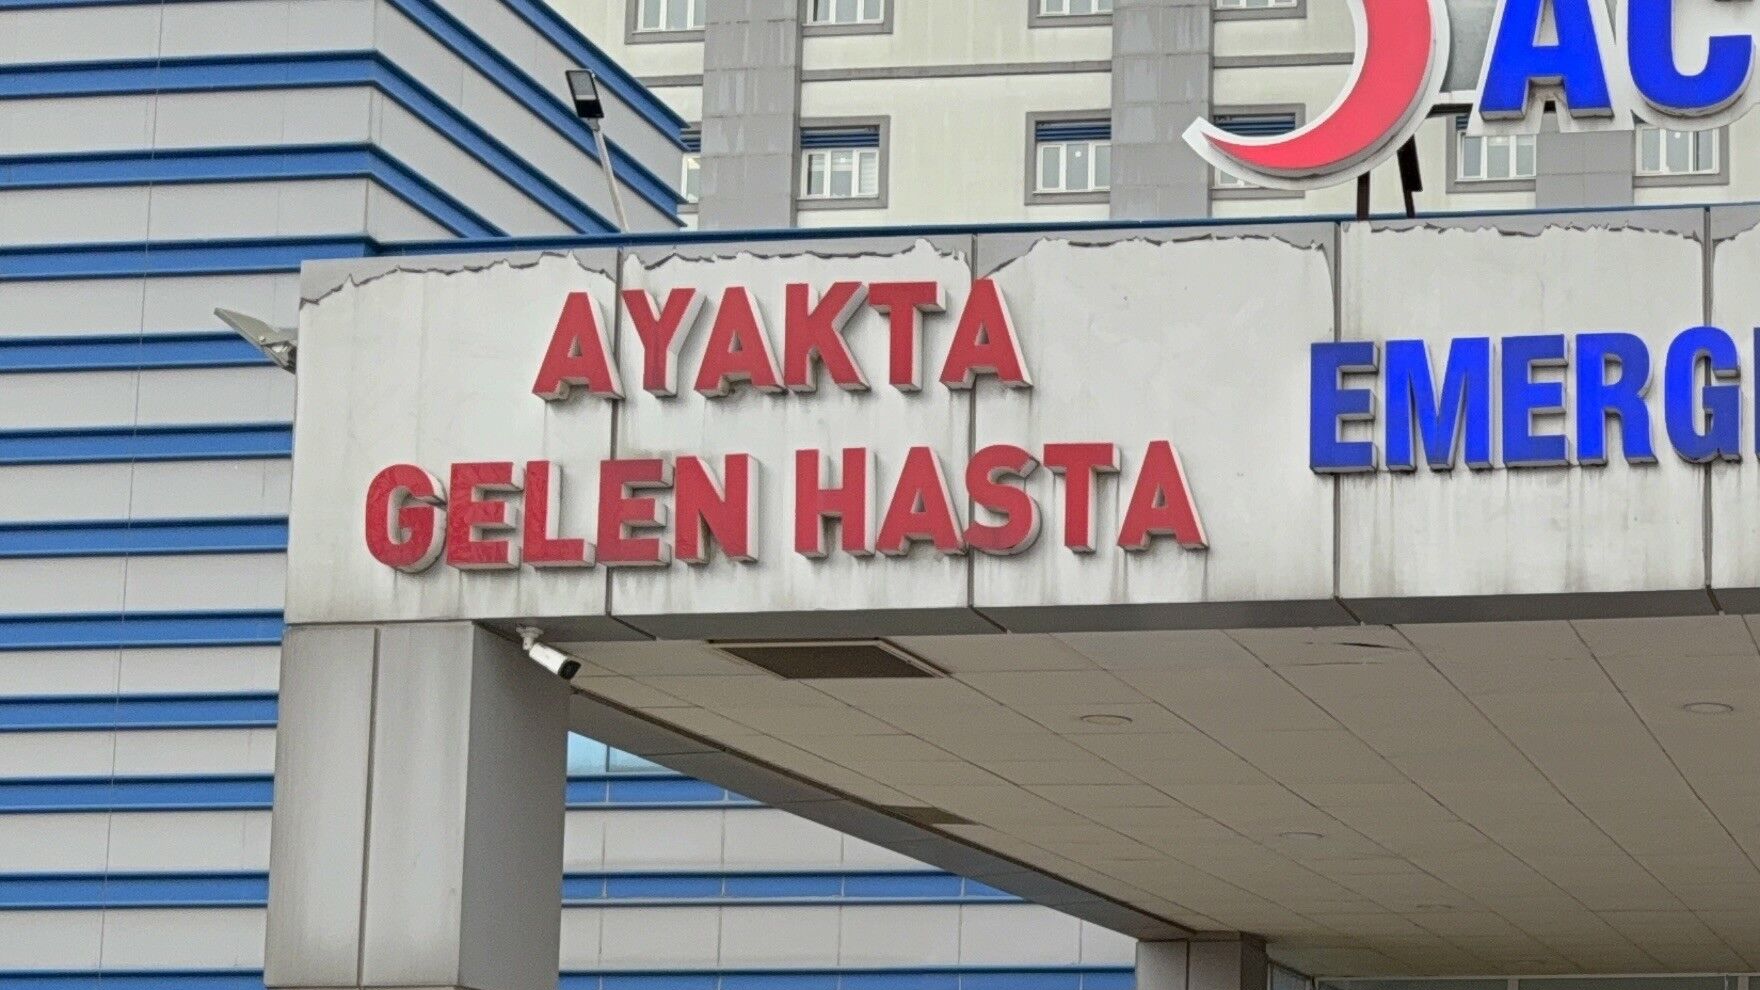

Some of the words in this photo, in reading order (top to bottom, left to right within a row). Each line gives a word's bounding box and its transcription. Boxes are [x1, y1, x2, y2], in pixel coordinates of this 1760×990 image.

[532, 278, 1033, 401] AYAKTA
[365, 453, 760, 573] GELEN
[795, 440, 1211, 558] HASTA
